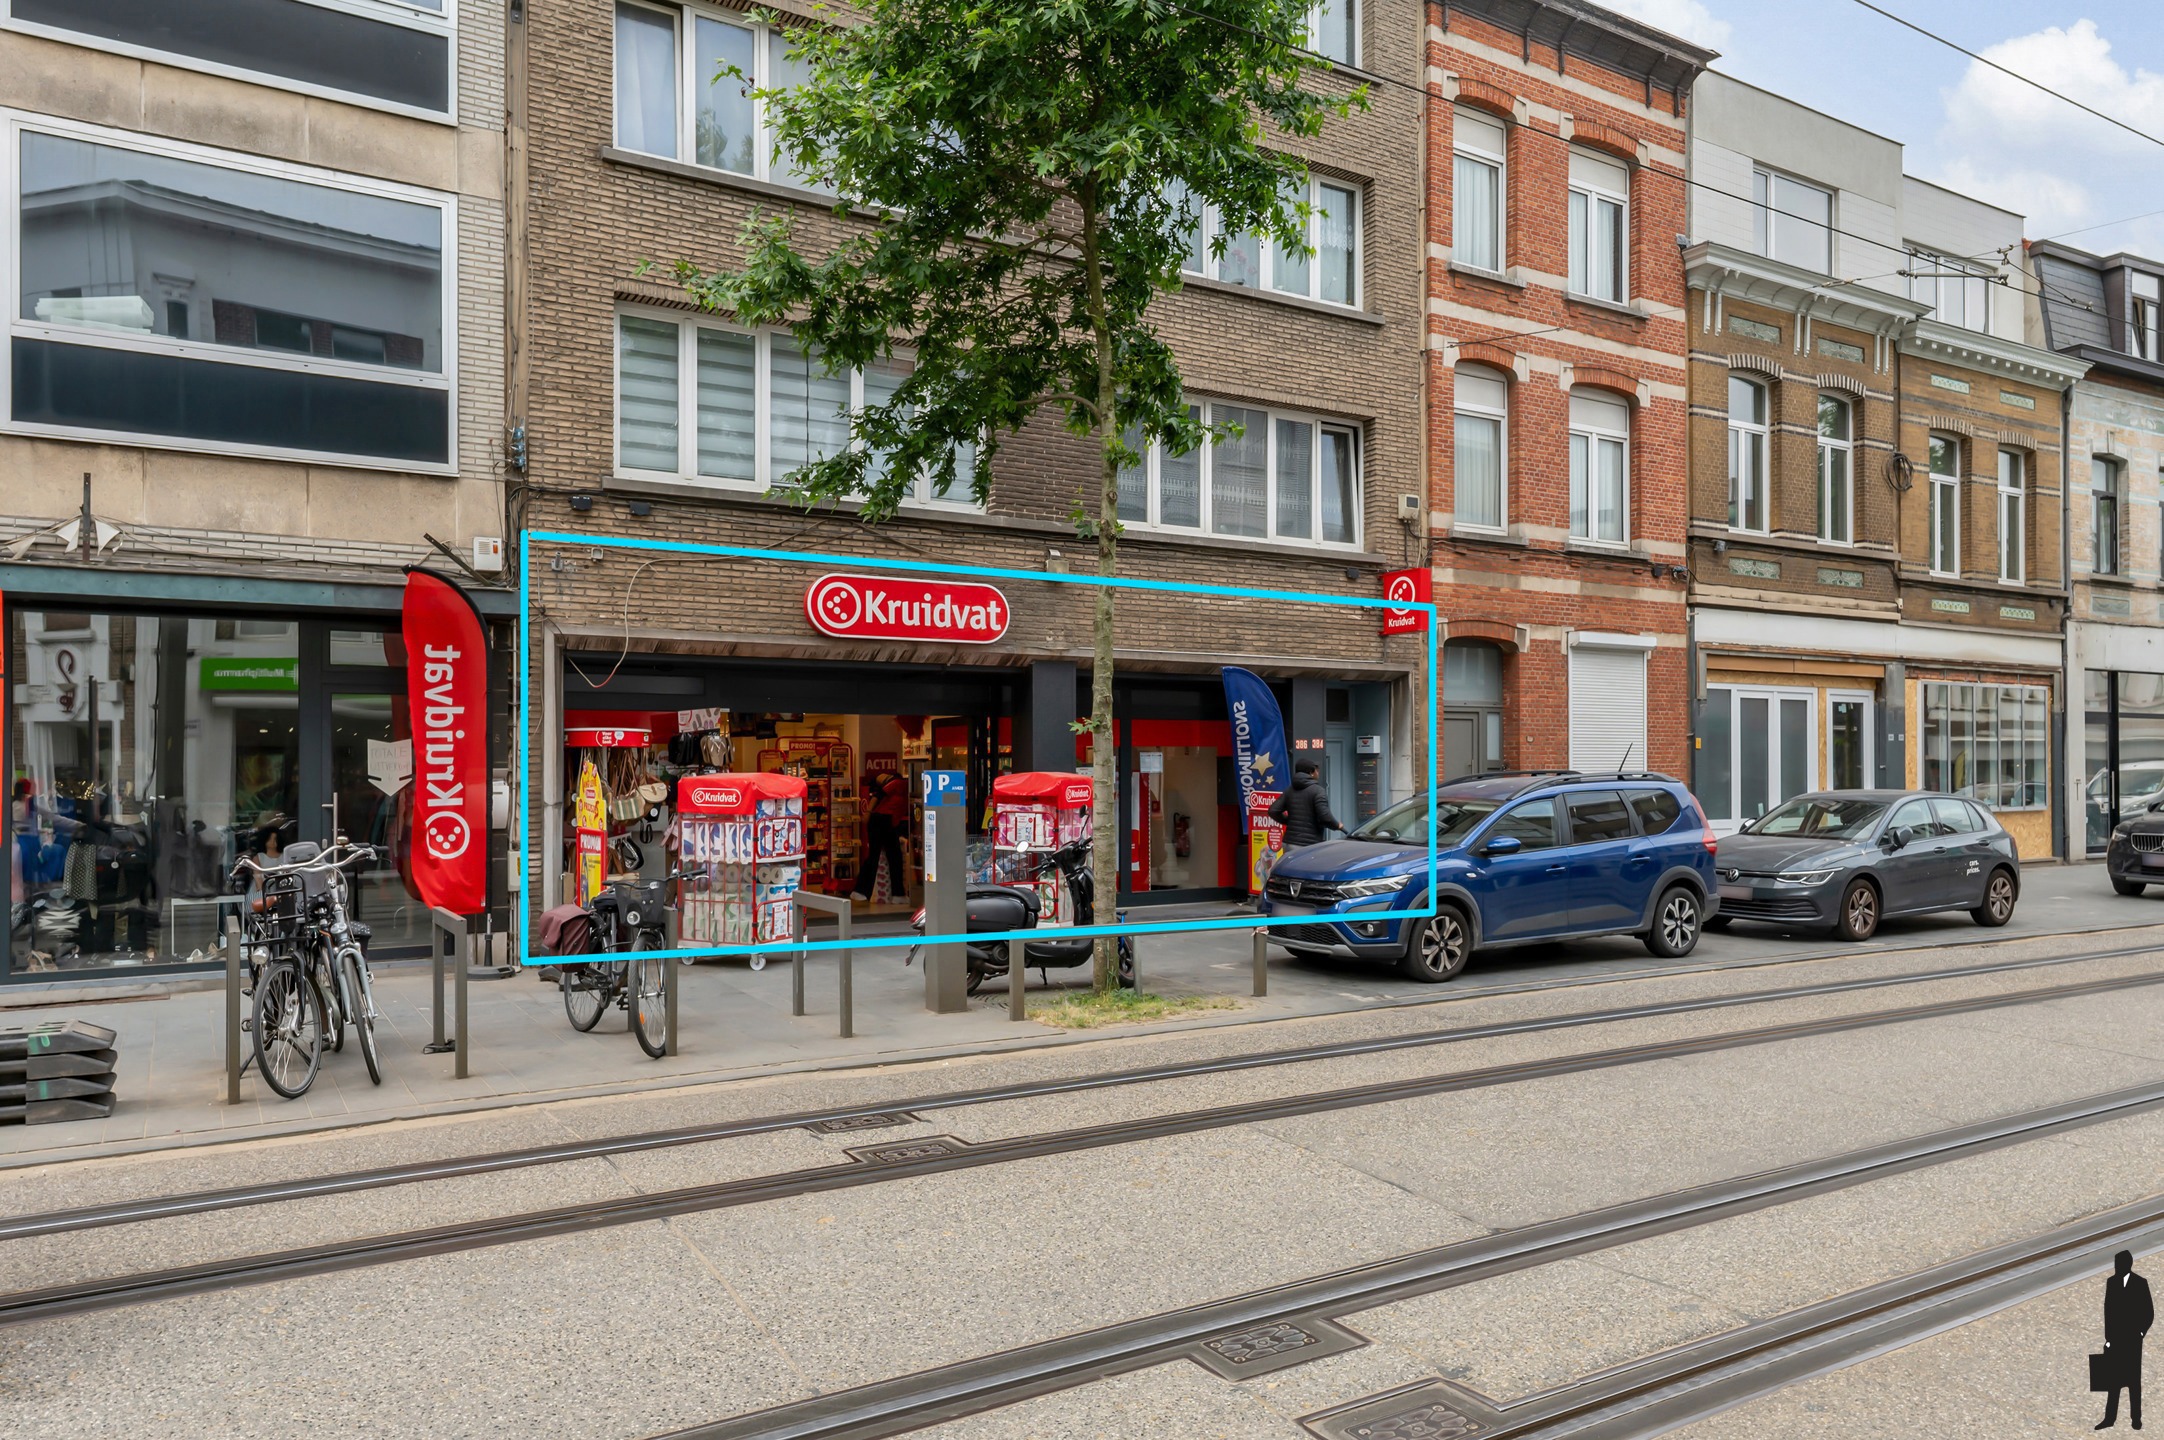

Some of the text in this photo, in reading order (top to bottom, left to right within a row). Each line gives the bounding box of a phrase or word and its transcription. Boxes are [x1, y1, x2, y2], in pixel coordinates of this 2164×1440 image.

[865, 590, 1001, 631] Kruidvat
[1388, 616, 1415, 627] Kruidvat
[1295, 739, 1308, 749] 386
[1312, 738, 1324, 748] 384
[938, 774, 950, 790] P
[705, 792, 737, 803] Kruidvat
[1258, 795, 1276, 806] Kruid
